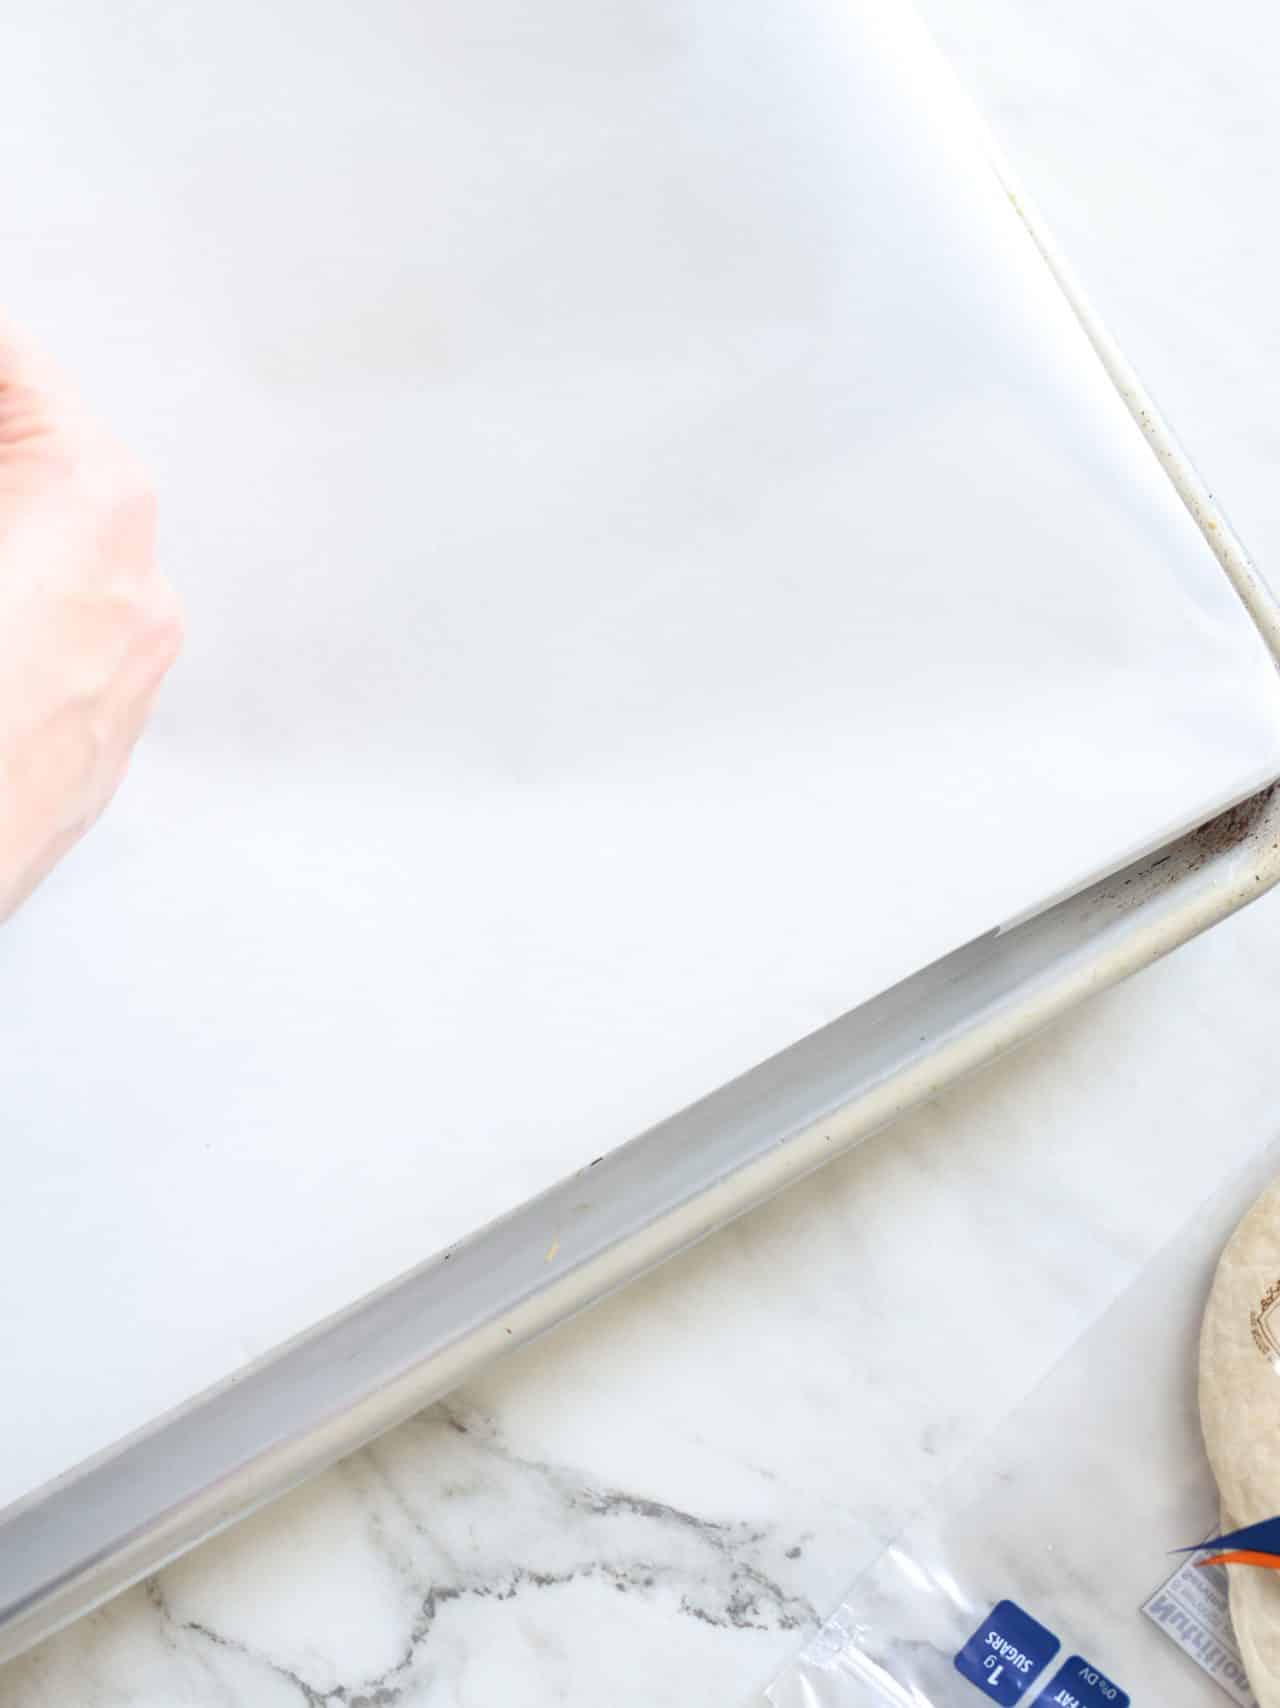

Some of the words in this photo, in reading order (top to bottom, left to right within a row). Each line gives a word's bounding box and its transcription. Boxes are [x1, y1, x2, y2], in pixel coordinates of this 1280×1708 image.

[984, 1631, 1033, 1673] SUGARS
[1078, 1667, 1099, 1686] DV
[1098, 1681, 1117, 1700] 0%
